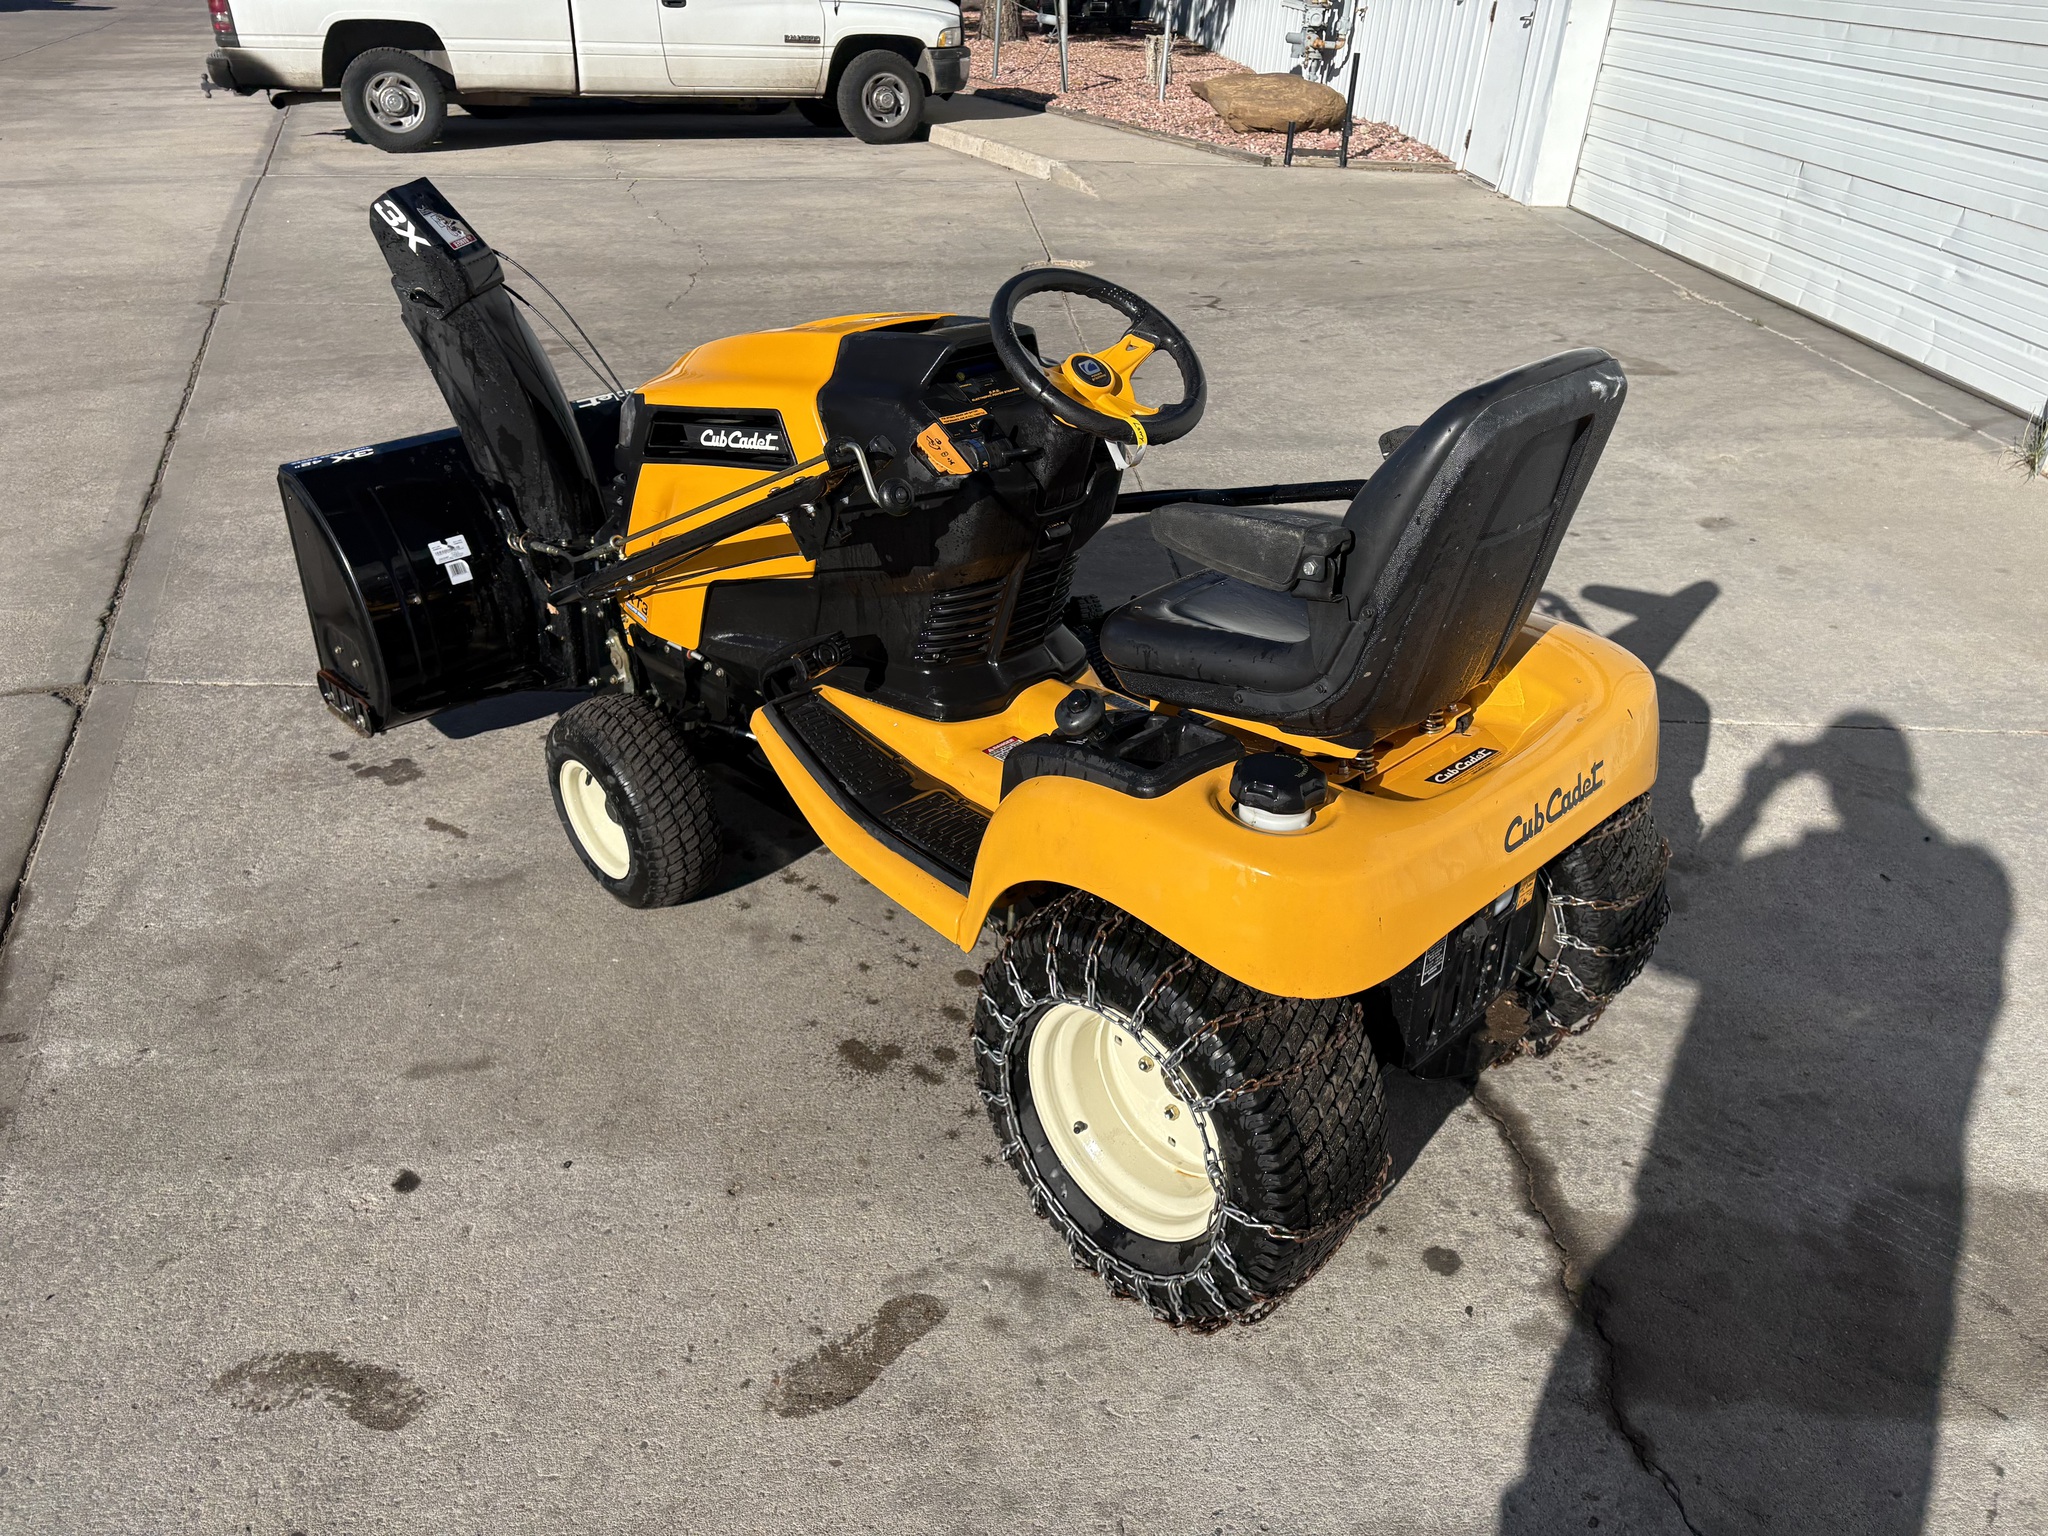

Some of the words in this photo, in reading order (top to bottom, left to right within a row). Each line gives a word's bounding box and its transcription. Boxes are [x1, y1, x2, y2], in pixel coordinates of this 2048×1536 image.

[374, 200, 432, 256] 3X
[330, 448, 374, 463] 3X
[700, 429, 728, 447] Cub
[728, 431, 779, 450] Cadet
[1434, 768, 1460, 783] Cub
[1455, 749, 1493, 771] Cadet
[1504, 803, 1545, 853] Cub
[1546, 760, 1604, 824] Cadet
